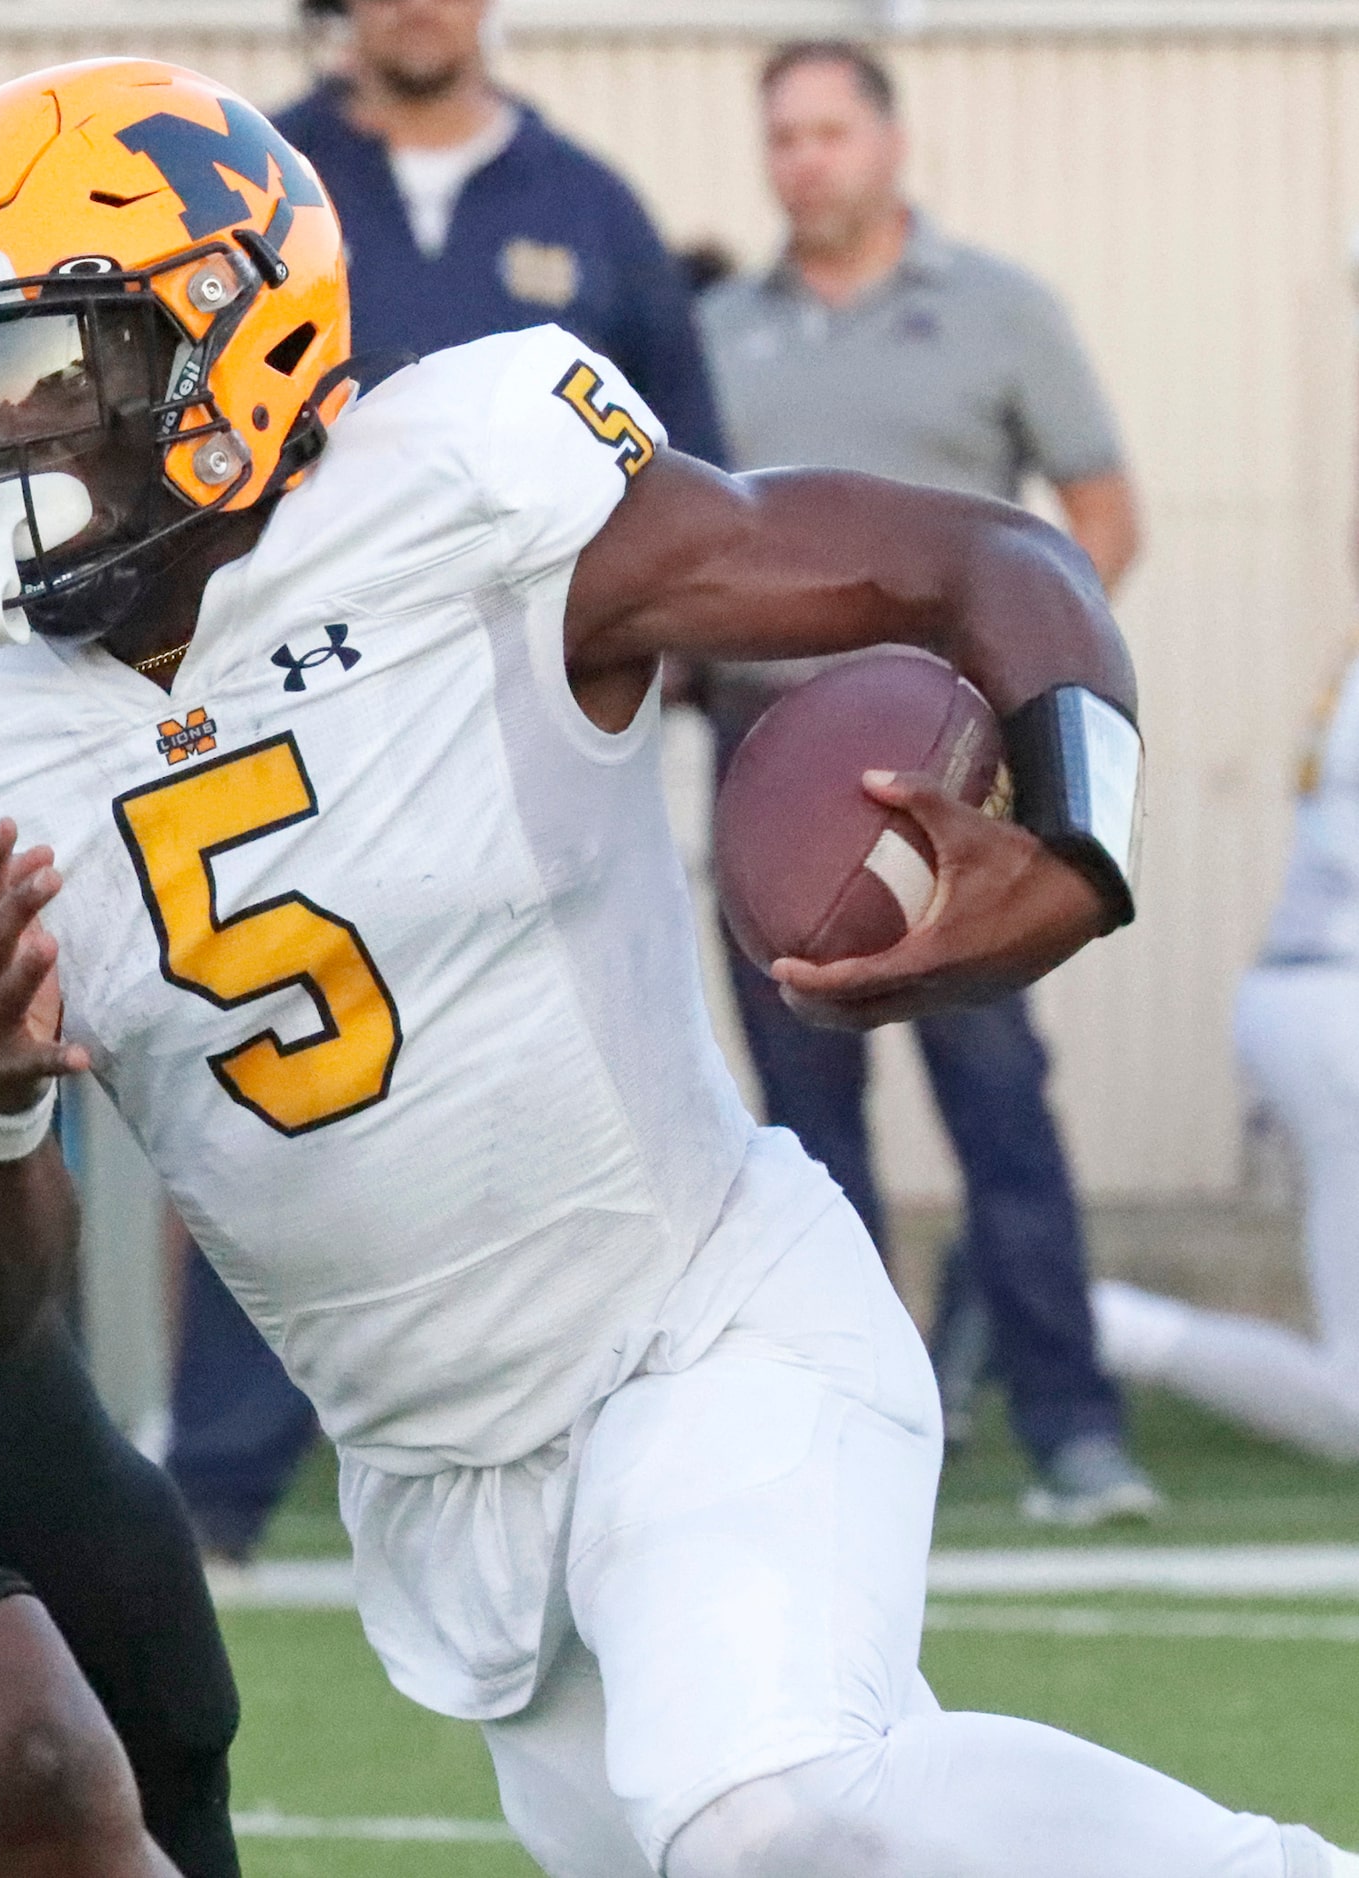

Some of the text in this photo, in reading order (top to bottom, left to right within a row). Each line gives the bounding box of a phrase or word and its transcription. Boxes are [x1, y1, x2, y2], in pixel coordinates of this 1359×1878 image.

[550, 358, 655, 479] 5
[159, 720, 215, 752] LIONS
[112, 729, 404, 1138] 5
